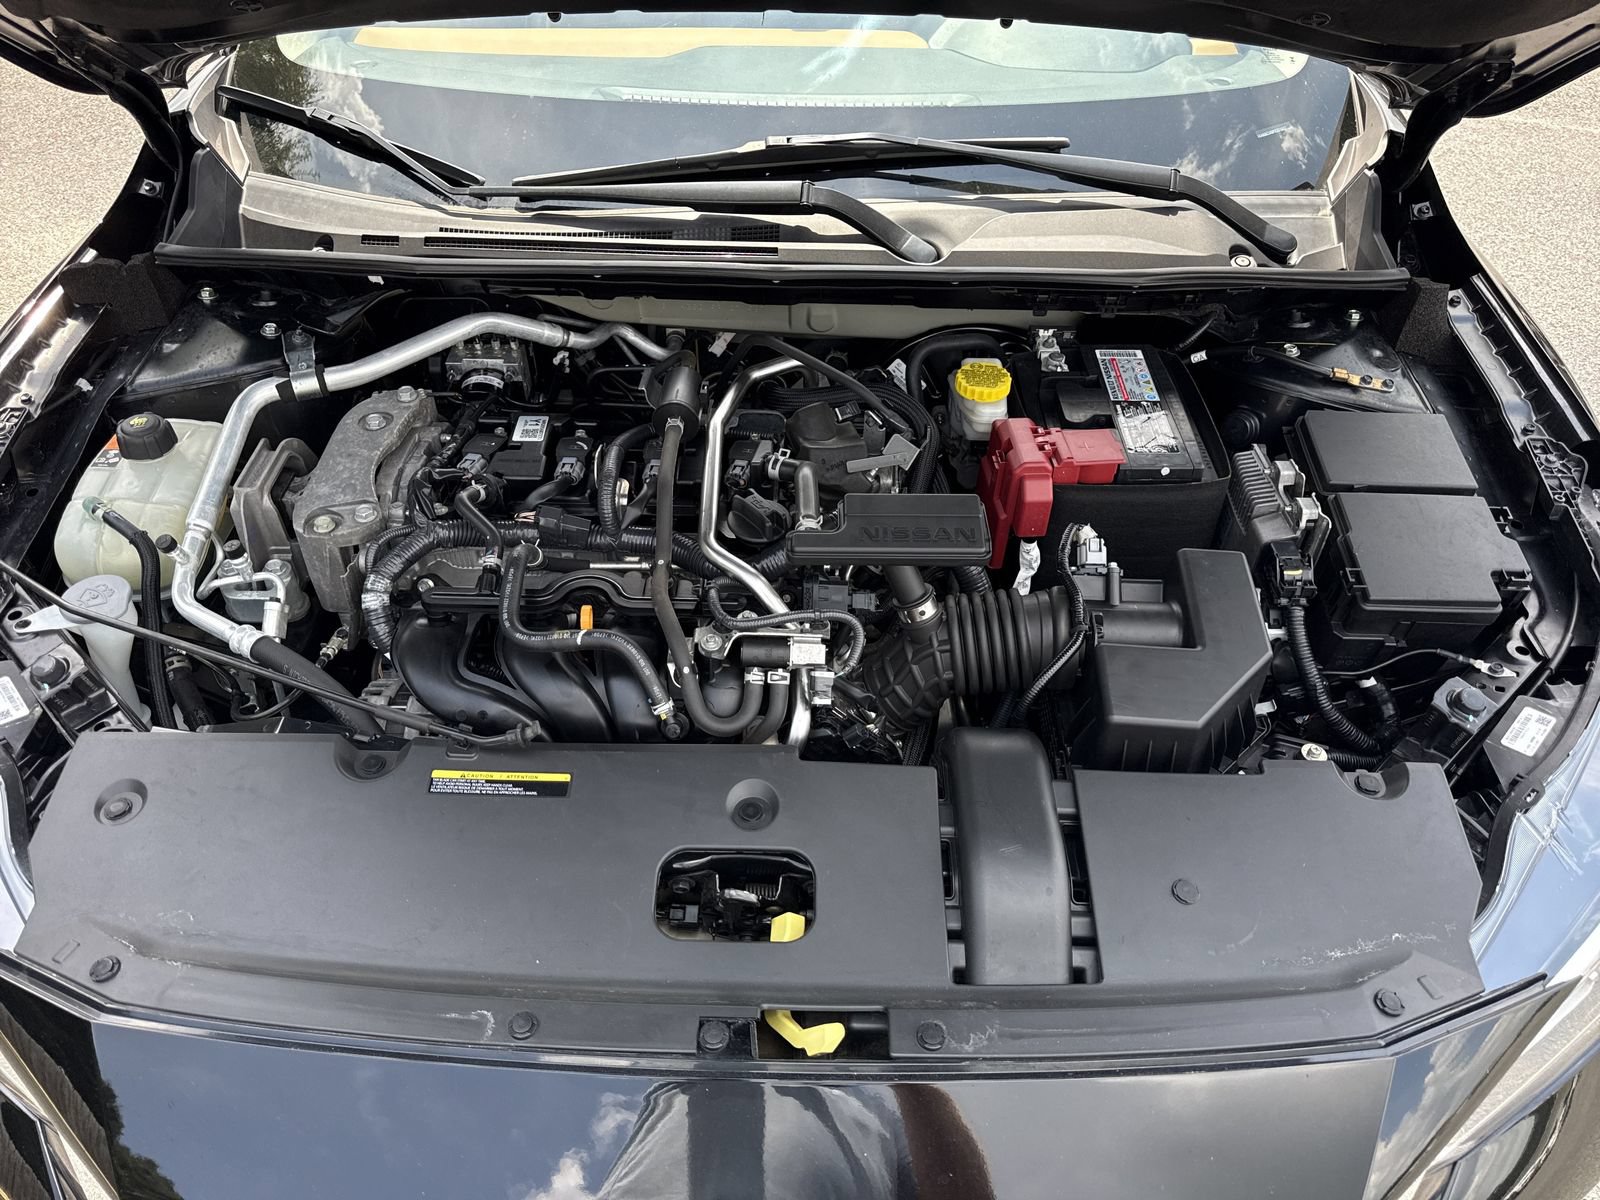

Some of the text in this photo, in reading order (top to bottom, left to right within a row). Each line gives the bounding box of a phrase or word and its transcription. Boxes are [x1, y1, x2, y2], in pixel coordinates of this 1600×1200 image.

[1100, 358, 1119, 400] RENAULT NISSAN
[860, 526, 976, 541] NISSAN
